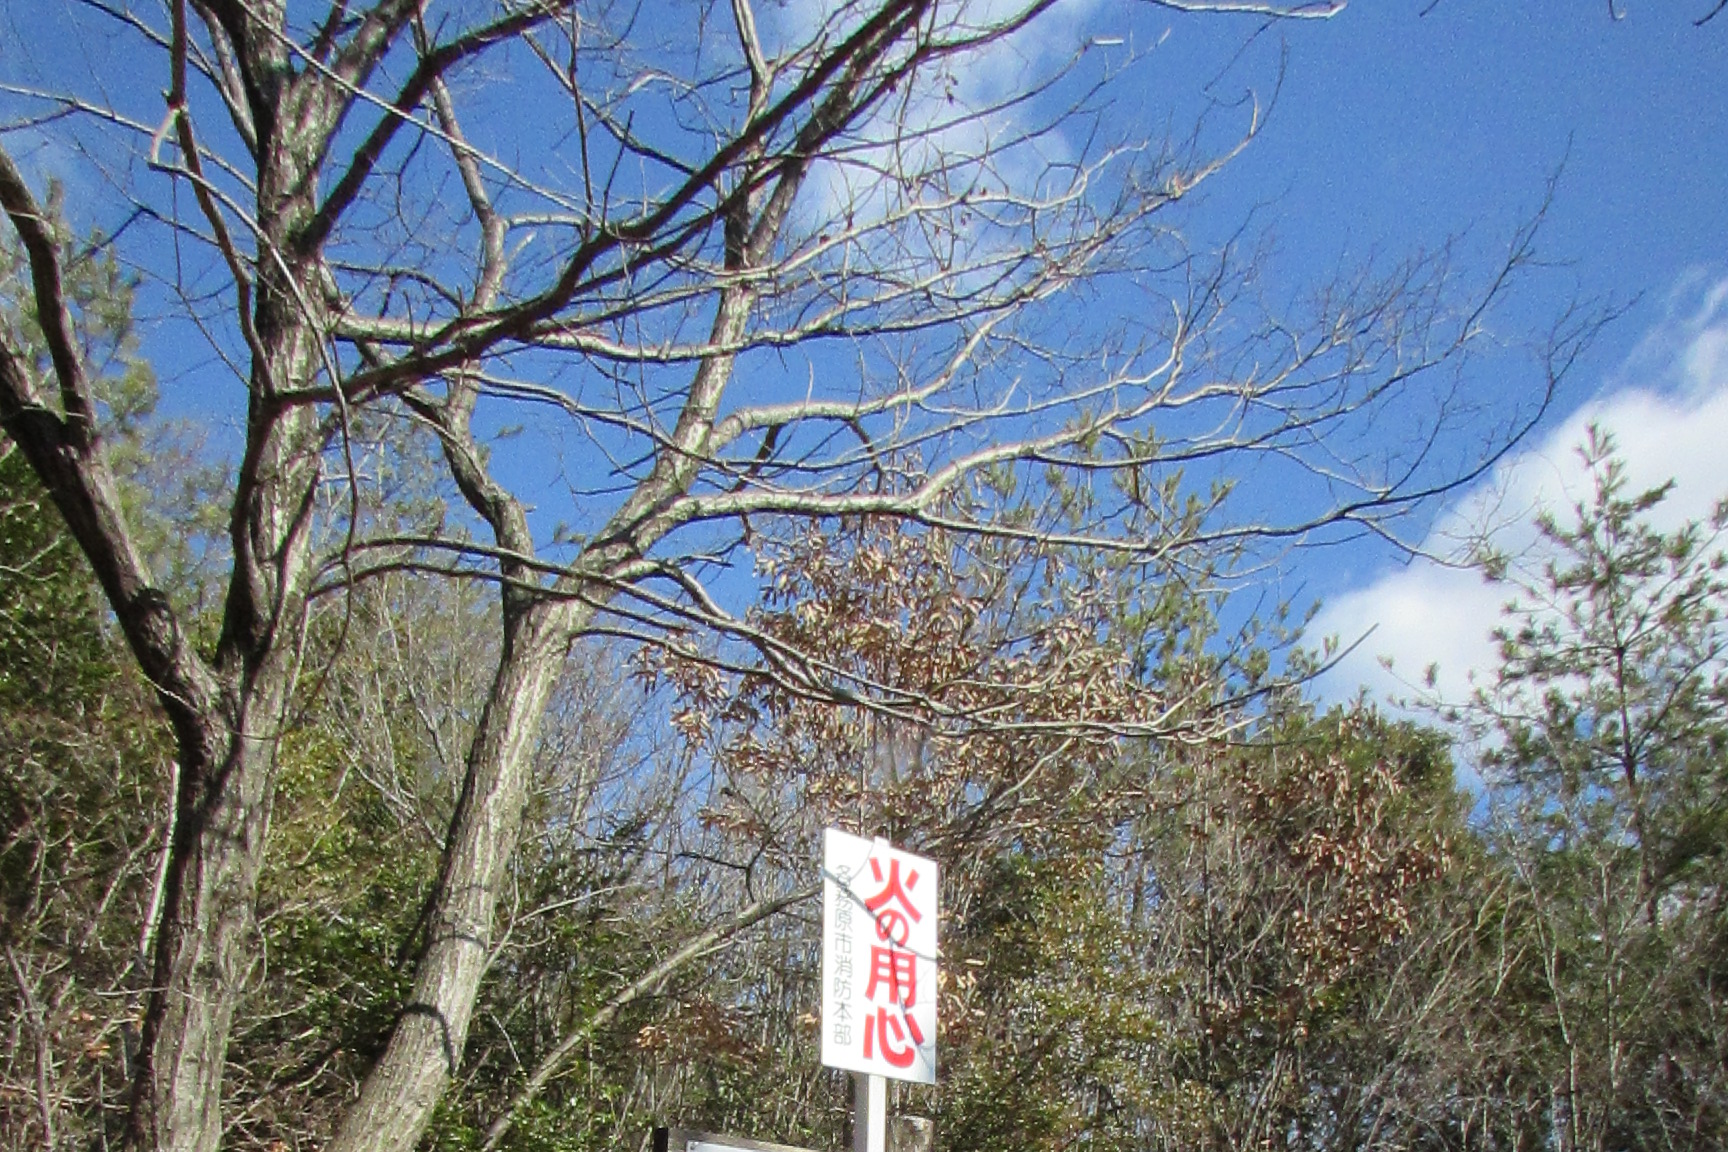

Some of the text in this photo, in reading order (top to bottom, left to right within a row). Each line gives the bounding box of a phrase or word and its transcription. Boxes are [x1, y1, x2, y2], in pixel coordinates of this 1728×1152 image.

[833, 864, 853, 1047] 各務原市消防本部
[864, 857, 924, 1069] 火の用心
